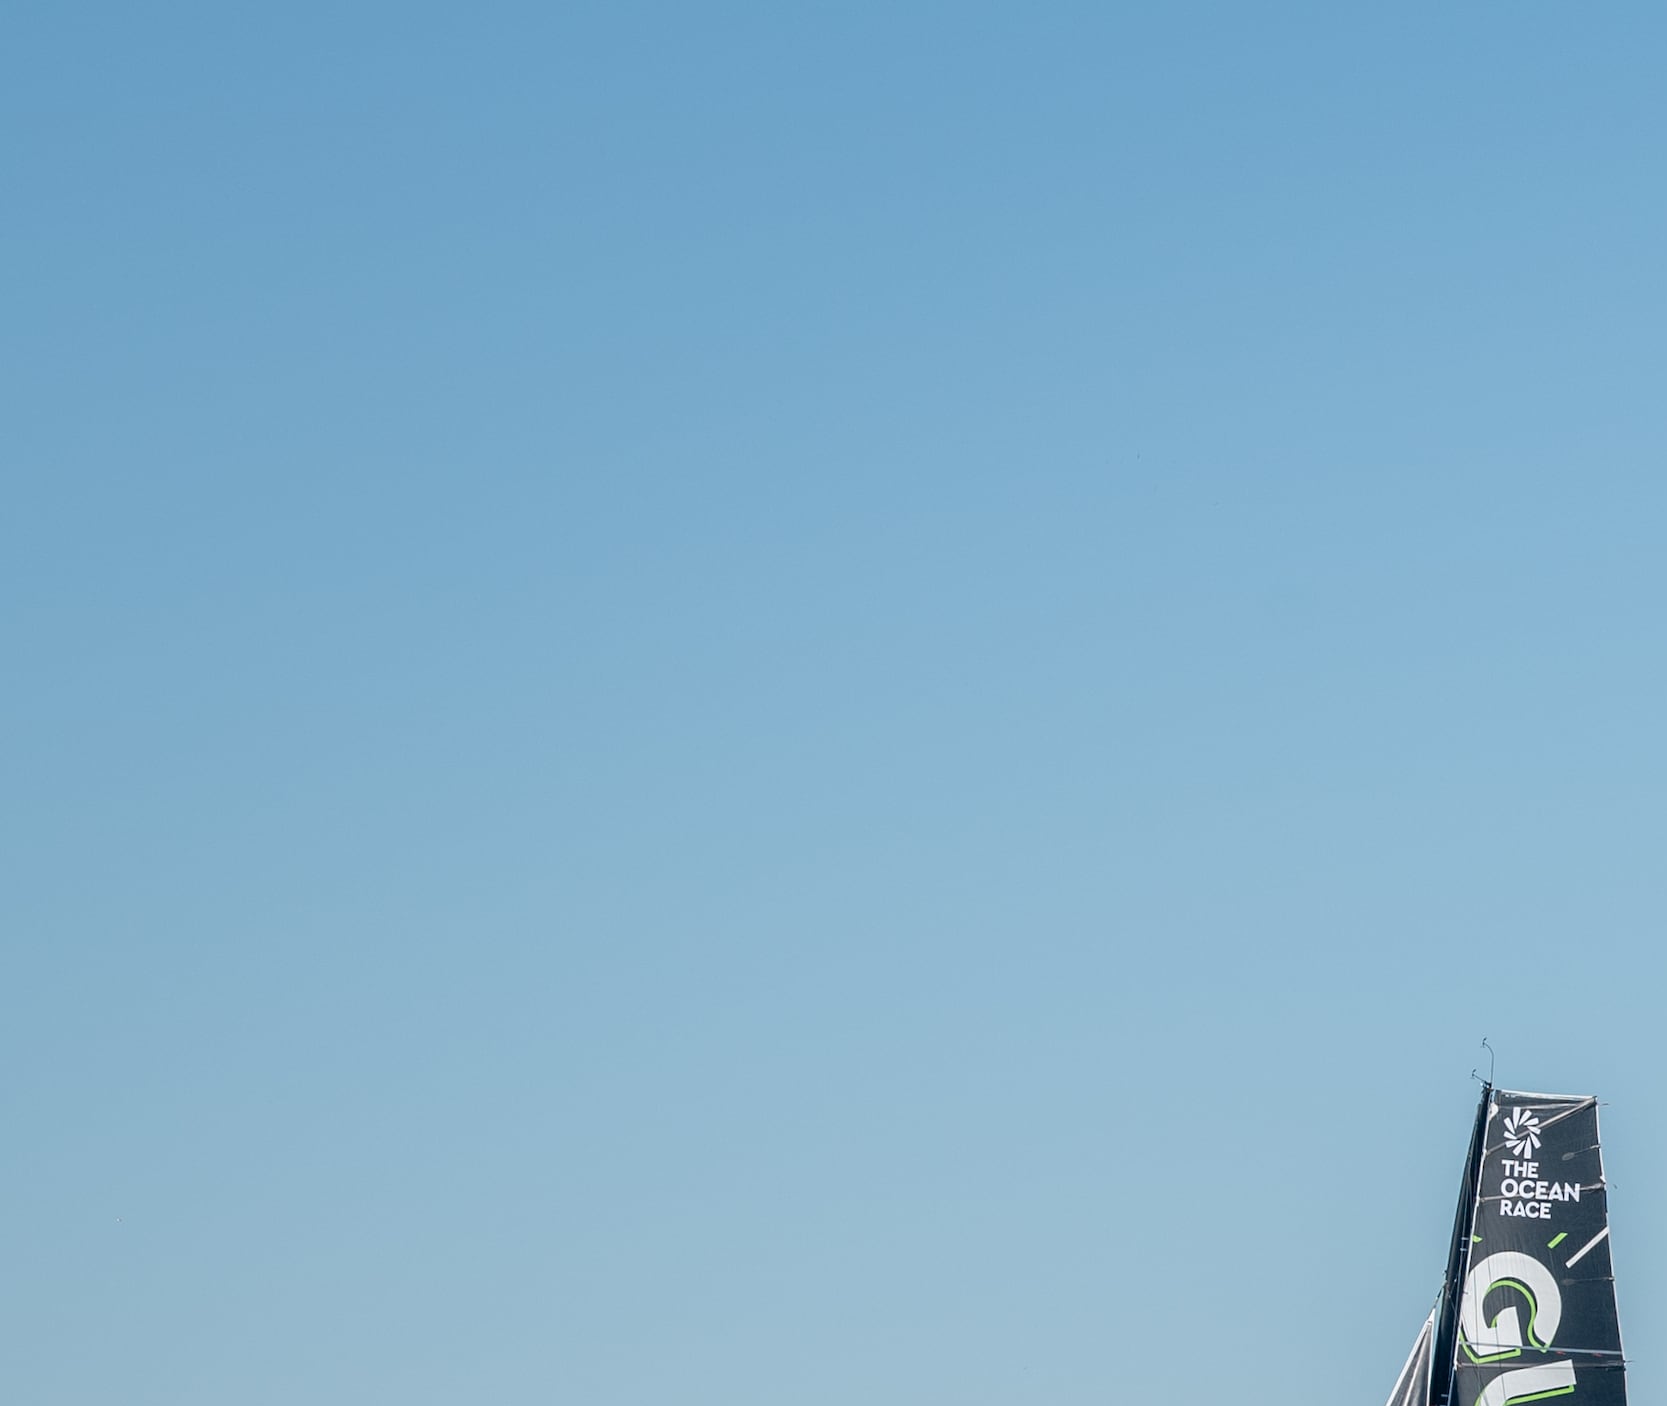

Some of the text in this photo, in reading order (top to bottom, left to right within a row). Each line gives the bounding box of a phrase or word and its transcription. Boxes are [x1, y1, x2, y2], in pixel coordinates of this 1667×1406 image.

[1501, 1159, 1540, 1179] THE
[1500, 1178, 1581, 1203] OCEAN
[1500, 1199, 1552, 1220] RACE
